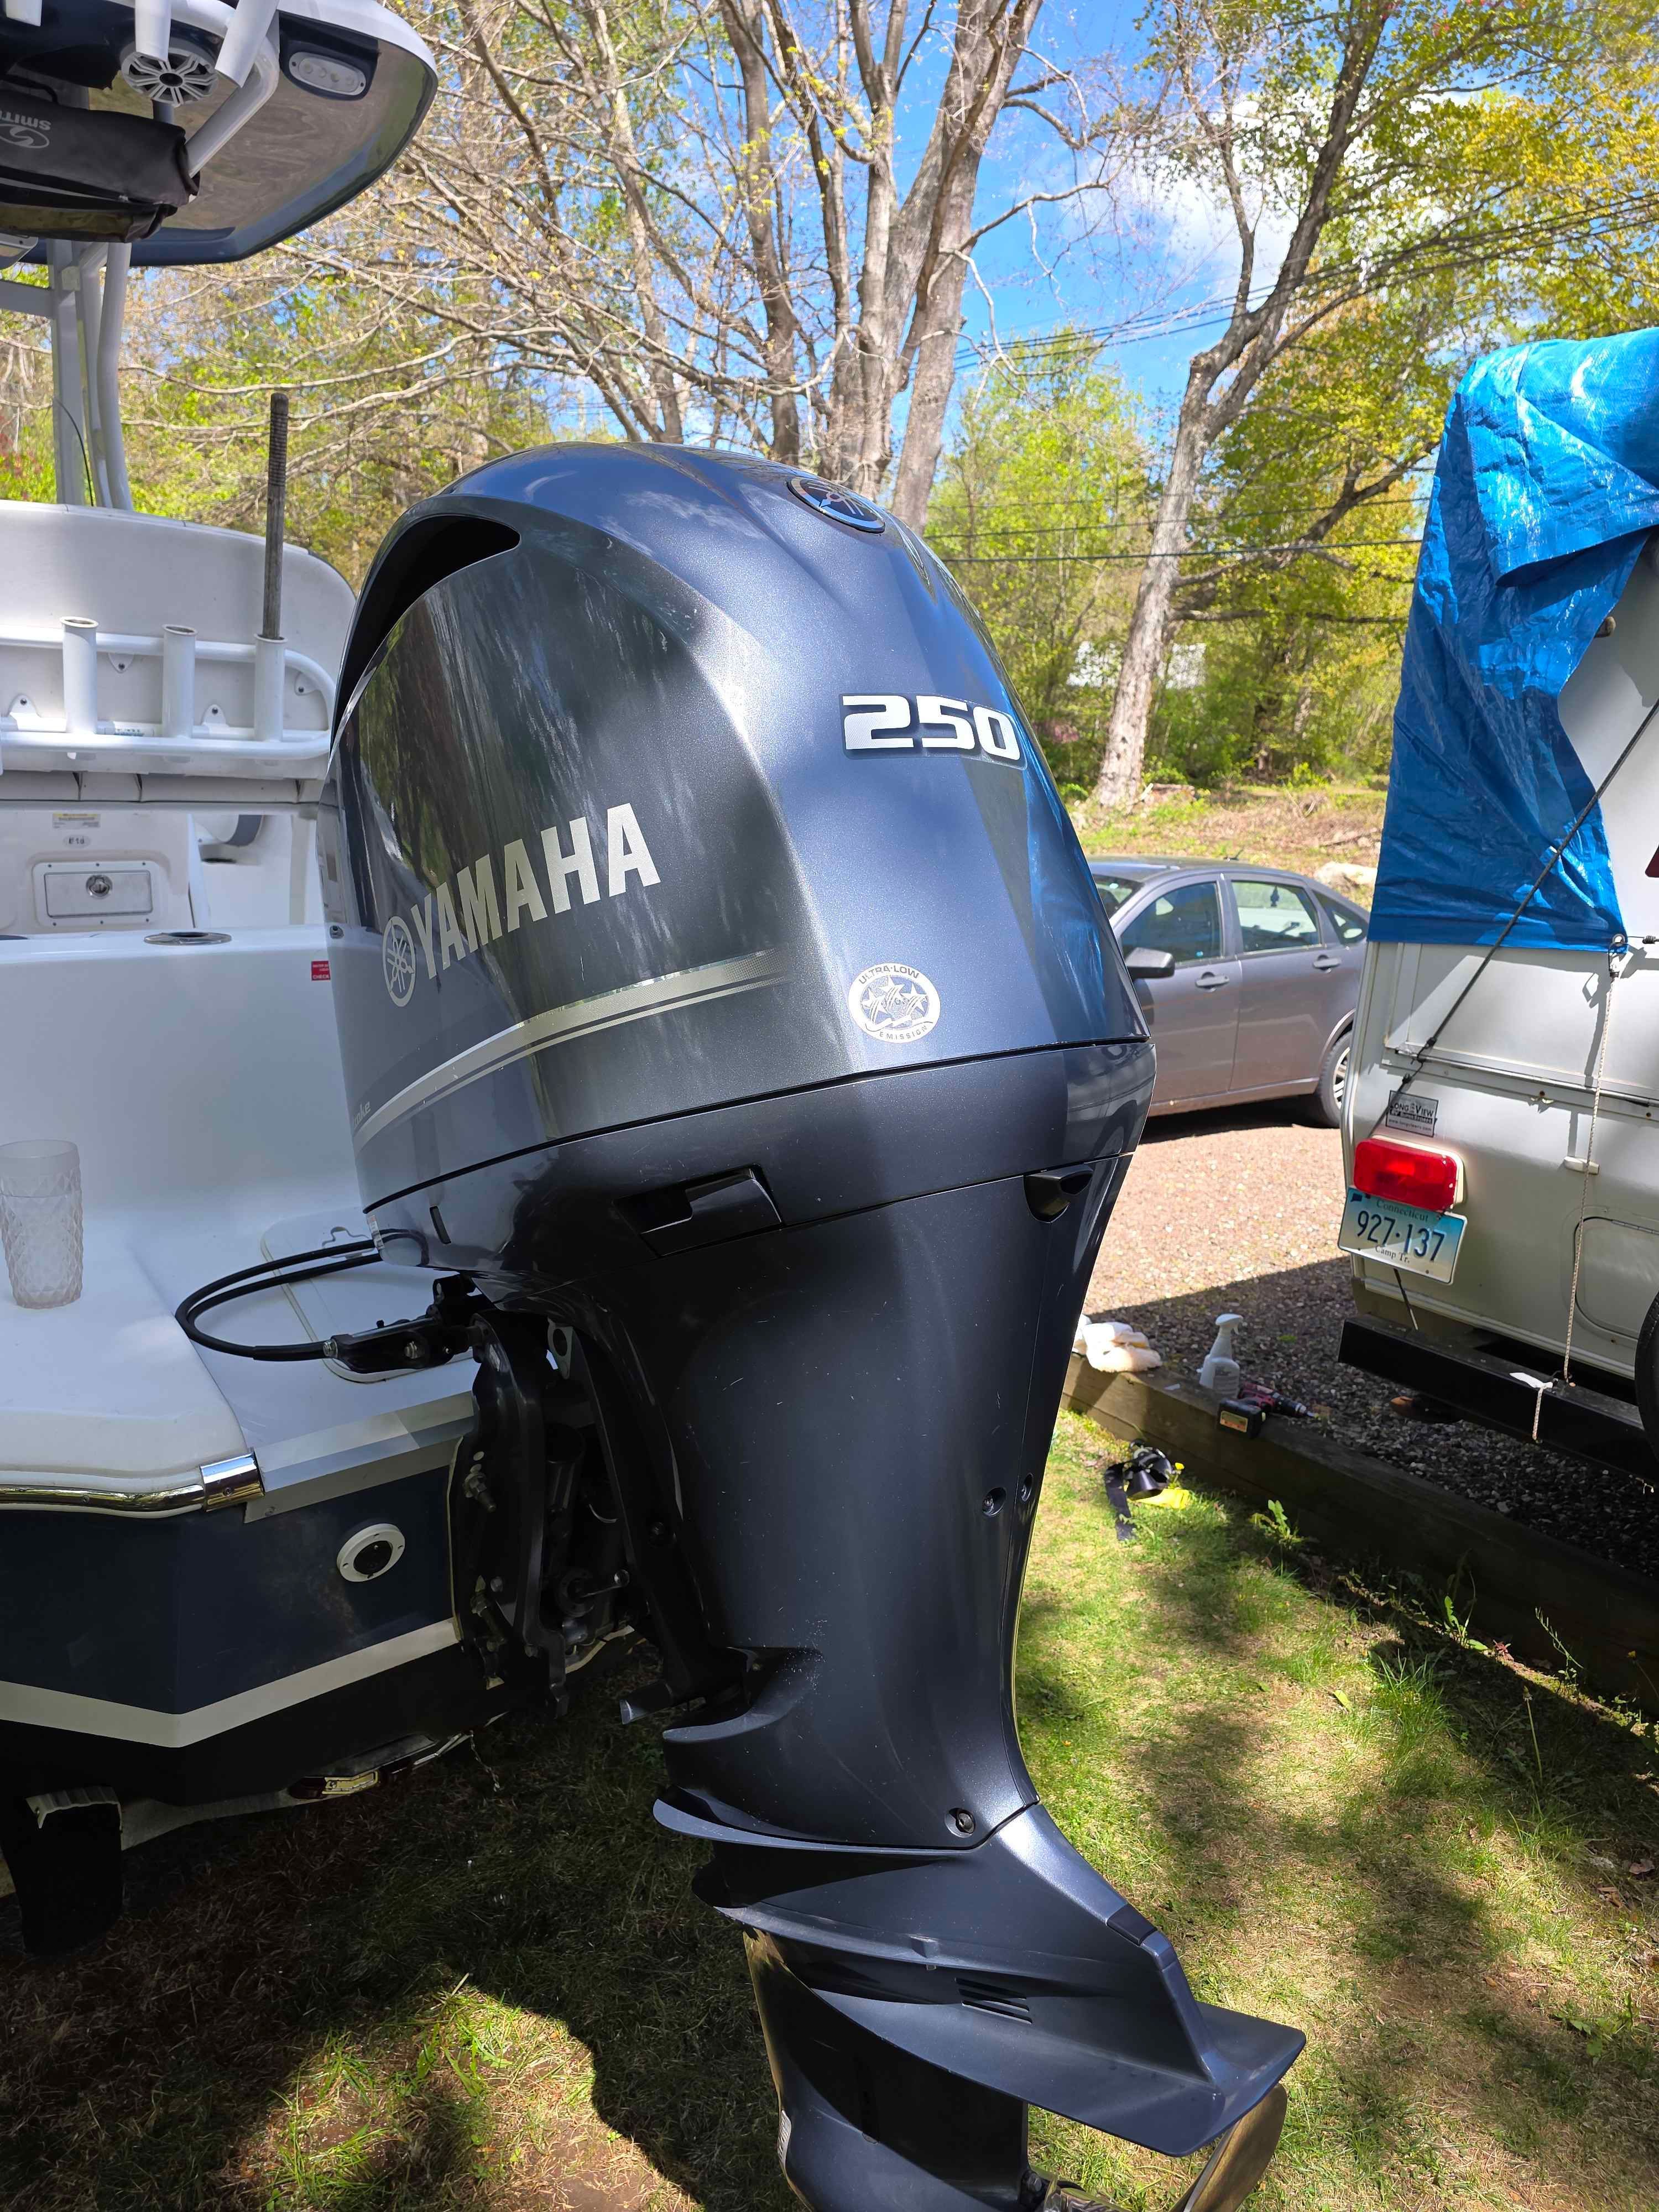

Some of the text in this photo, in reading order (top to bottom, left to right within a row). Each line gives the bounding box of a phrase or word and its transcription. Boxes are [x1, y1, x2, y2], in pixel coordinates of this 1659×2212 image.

[843, 695, 1020, 760] 250
[411, 803, 661, 979] YAMAHA
[879, 1025, 927, 1040] EMISSION
[1376, 1199, 1429, 1222] Connecticut
[1375, 1246, 1410, 1264] Camp Tr.
